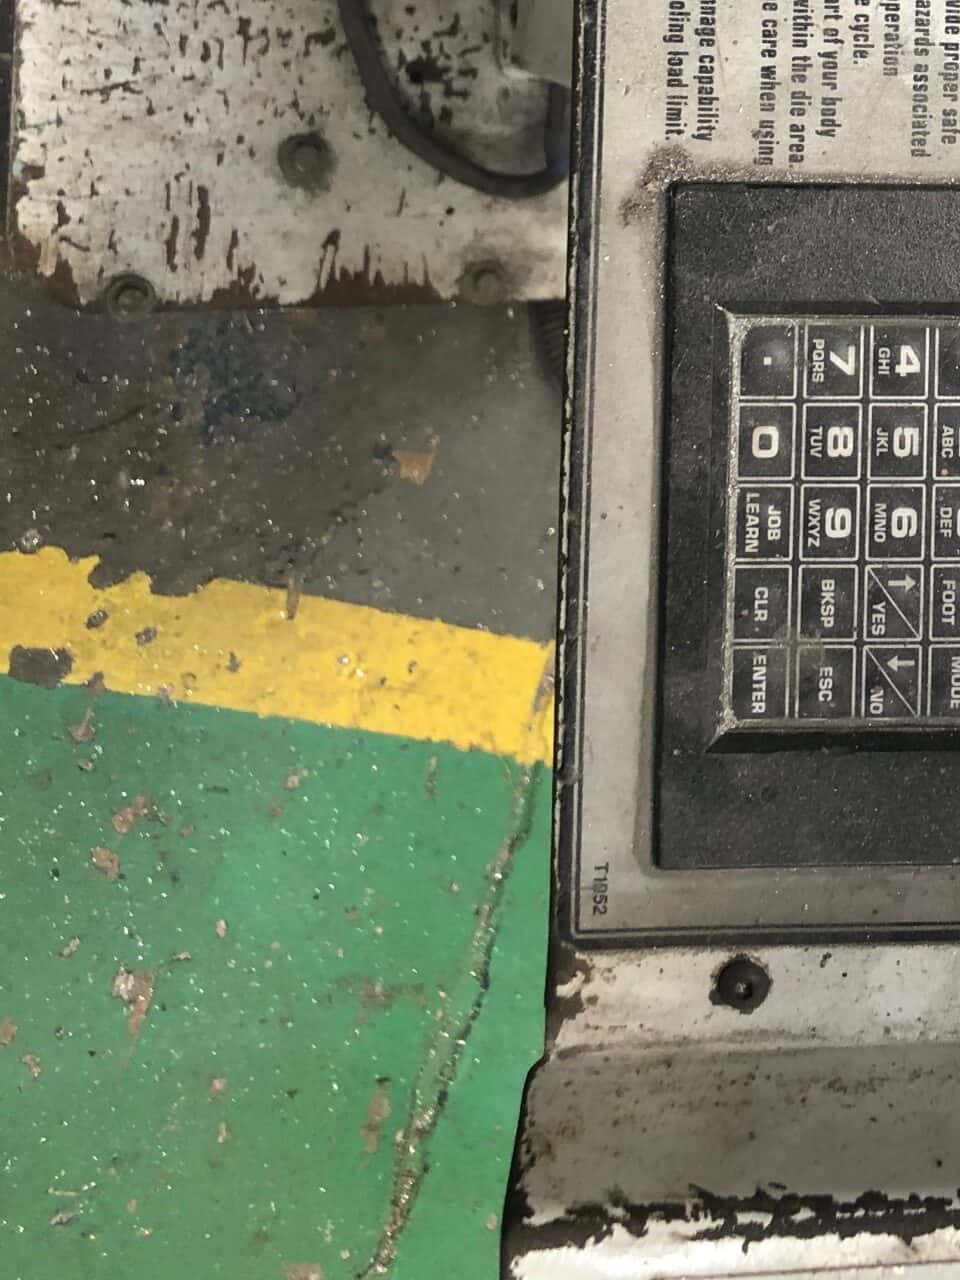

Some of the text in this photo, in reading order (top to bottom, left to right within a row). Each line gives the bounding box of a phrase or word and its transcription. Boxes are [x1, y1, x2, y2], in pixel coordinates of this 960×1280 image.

[761, 20, 780, 58] care
[823, 28, 843, 45] of
[849, 14, 873, 65] cycle.
[666, 51, 689, 87] load
[791, 56, 812, 83] the
[818, 51, 839, 90] your
[938, 42, 959, 102] proper
[692, 55, 719, 142] capability
[759, 65, 781, 112] when
[789, 91, 811, 117] die
[665, 95, 688, 140] limit.
[816, 97, 842, 138] body
[910, 64, 932, 157] associated
[754, 120, 779, 166] using
[788, 124, 807, 169] area.
[811, 339, 825, 383] PQRS
[829, 344, 855, 376] 7
[877, 347, 890, 375] GHI
[895, 345, 920, 376] 4
[751, 425, 779, 458] 0
[809, 426, 822, 457] TUV
[827, 426, 854, 458] 8
[876, 427, 889, 456] JKL
[893, 426, 919, 458] 5
[941, 425, 955, 458] ABC
[745, 492, 759, 552] LEARN
[767, 505, 781, 540] JOB
[807, 499, 820, 547] WXYZ
[825, 507, 852, 538] 9
[873, 503, 887, 542] MNO
[891, 507, 918, 538] 6
[939, 507, 953, 538] DEF
[754, 587, 768, 622] CLR
[821, 579, 835, 628] BKSP
[871, 601, 885, 635] YES
[941, 580, 955, 625] FOOT
[751, 655, 767, 713] ENTER
[818, 666, 833, 702] ESC
[870, 689, 884, 714] NO
